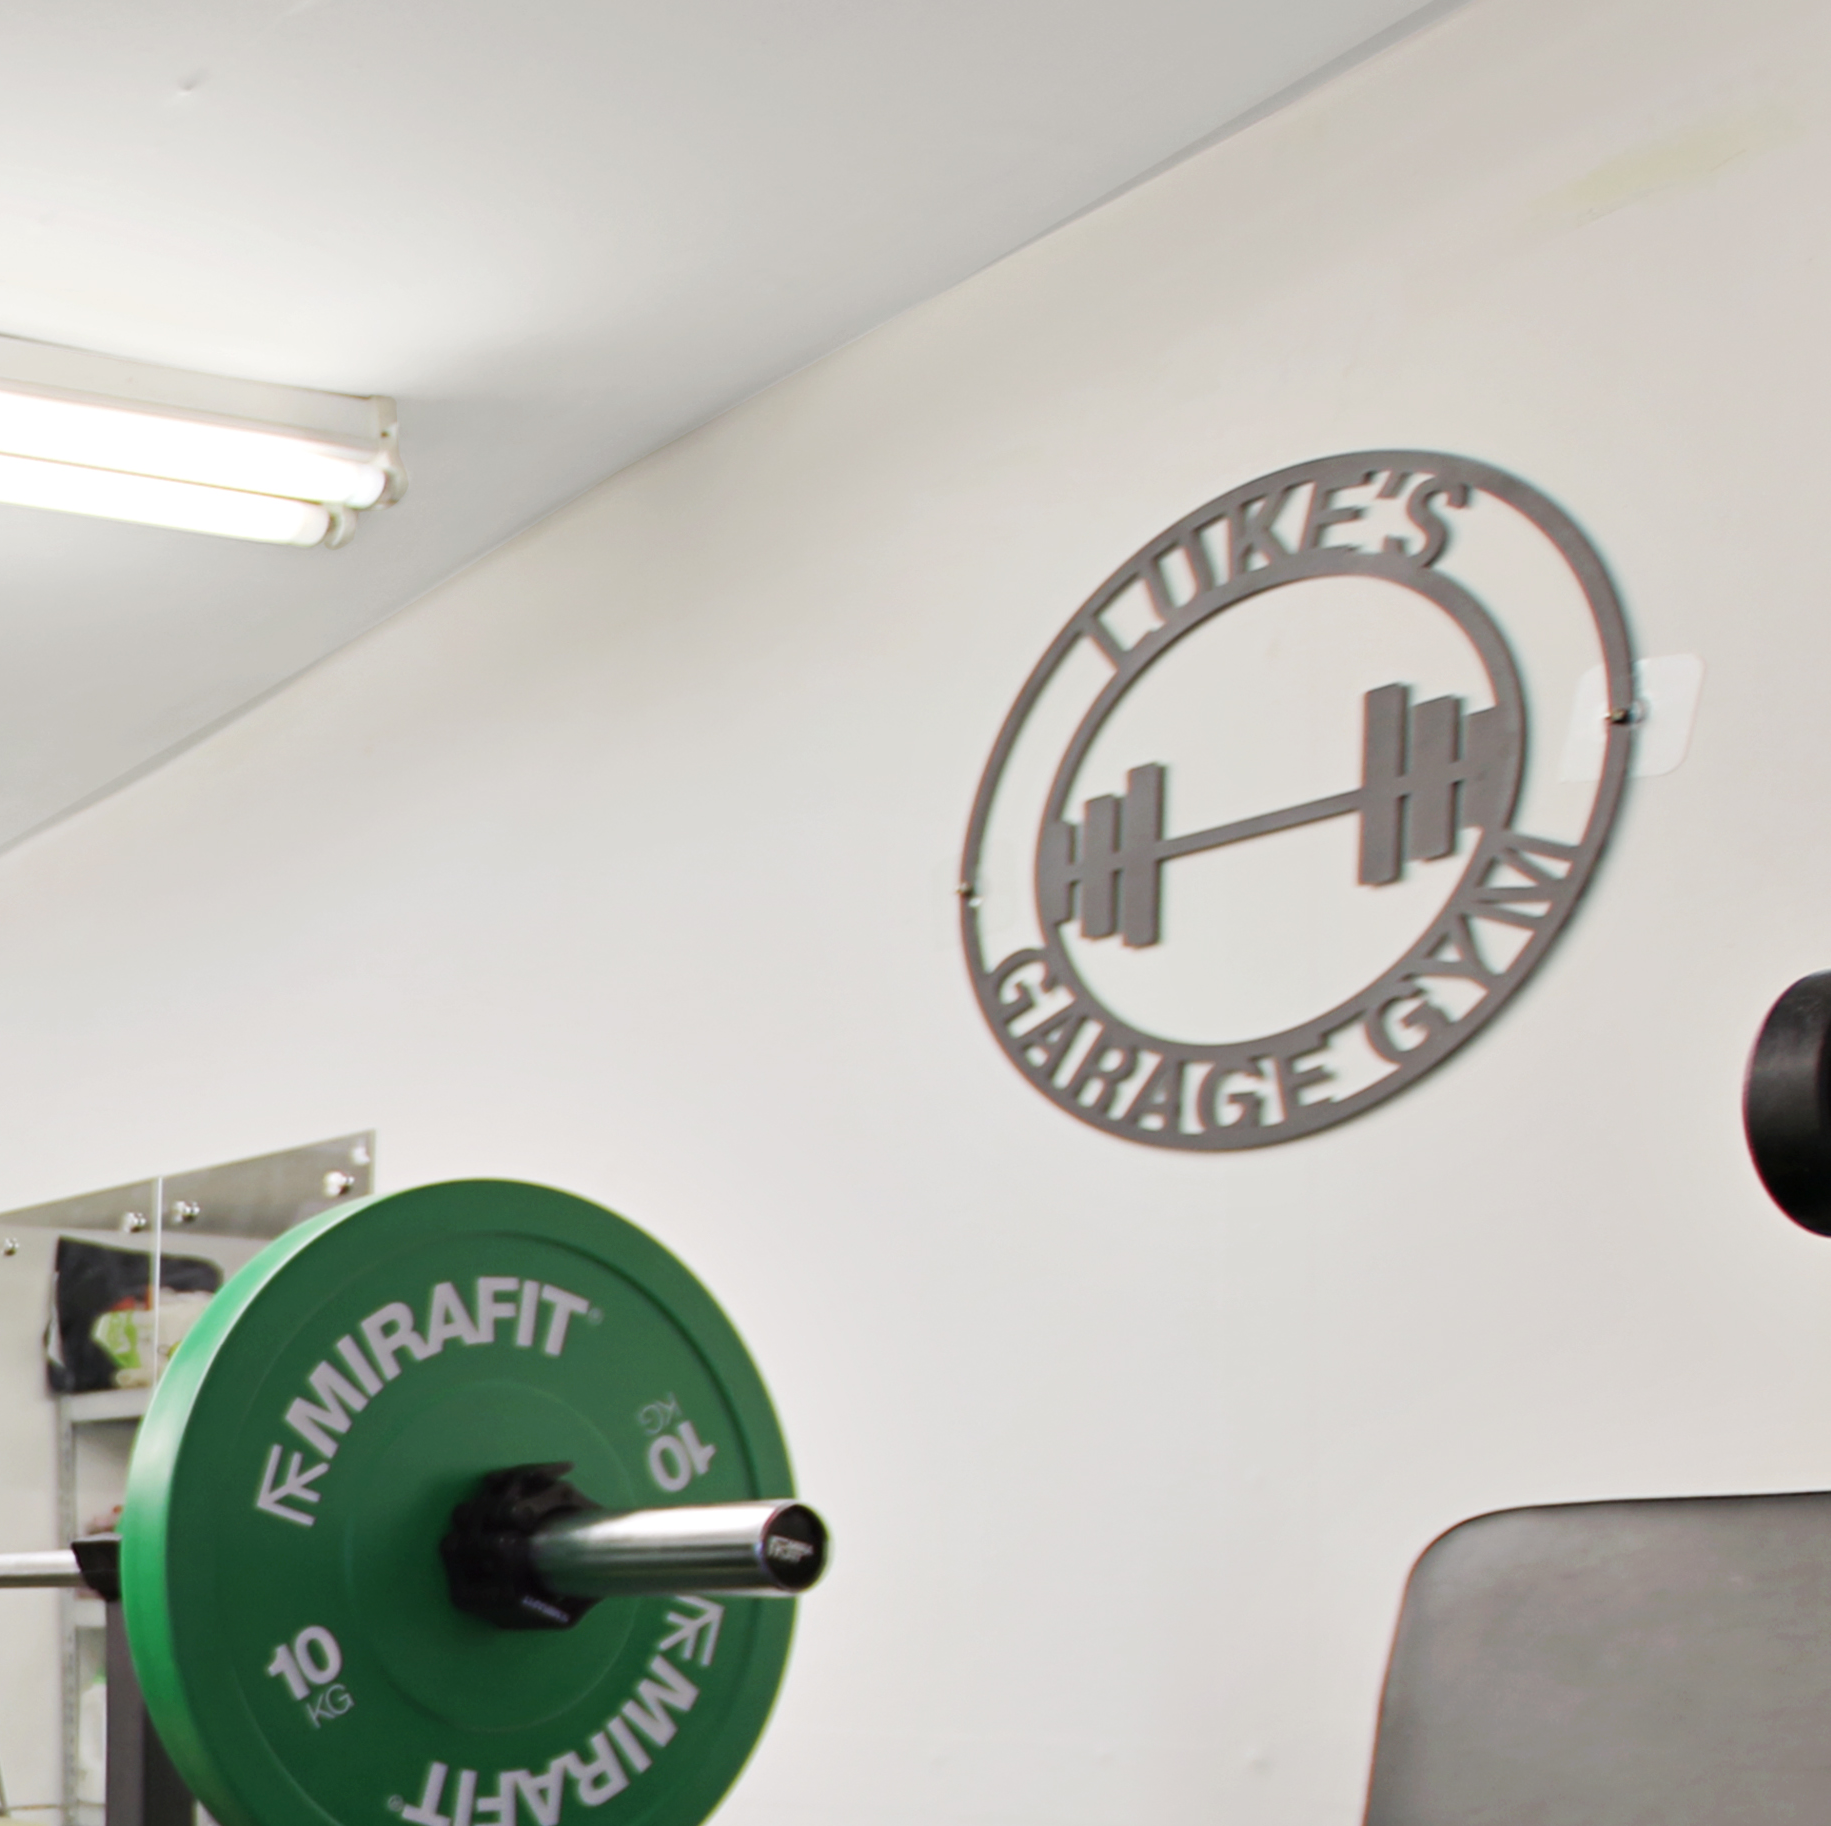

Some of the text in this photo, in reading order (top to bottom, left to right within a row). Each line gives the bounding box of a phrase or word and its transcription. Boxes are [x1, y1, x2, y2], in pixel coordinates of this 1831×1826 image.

[1084, 469, 1471, 671] LUKE'S
[989, 829, 1587, 1136] GARAGE GYM
[284, 1275, 590, 1457] MIRAFIT
[648, 1419, 717, 1493] 10
[266, 1625, 343, 1701] 10
[306, 1682, 355, 1728] KG
